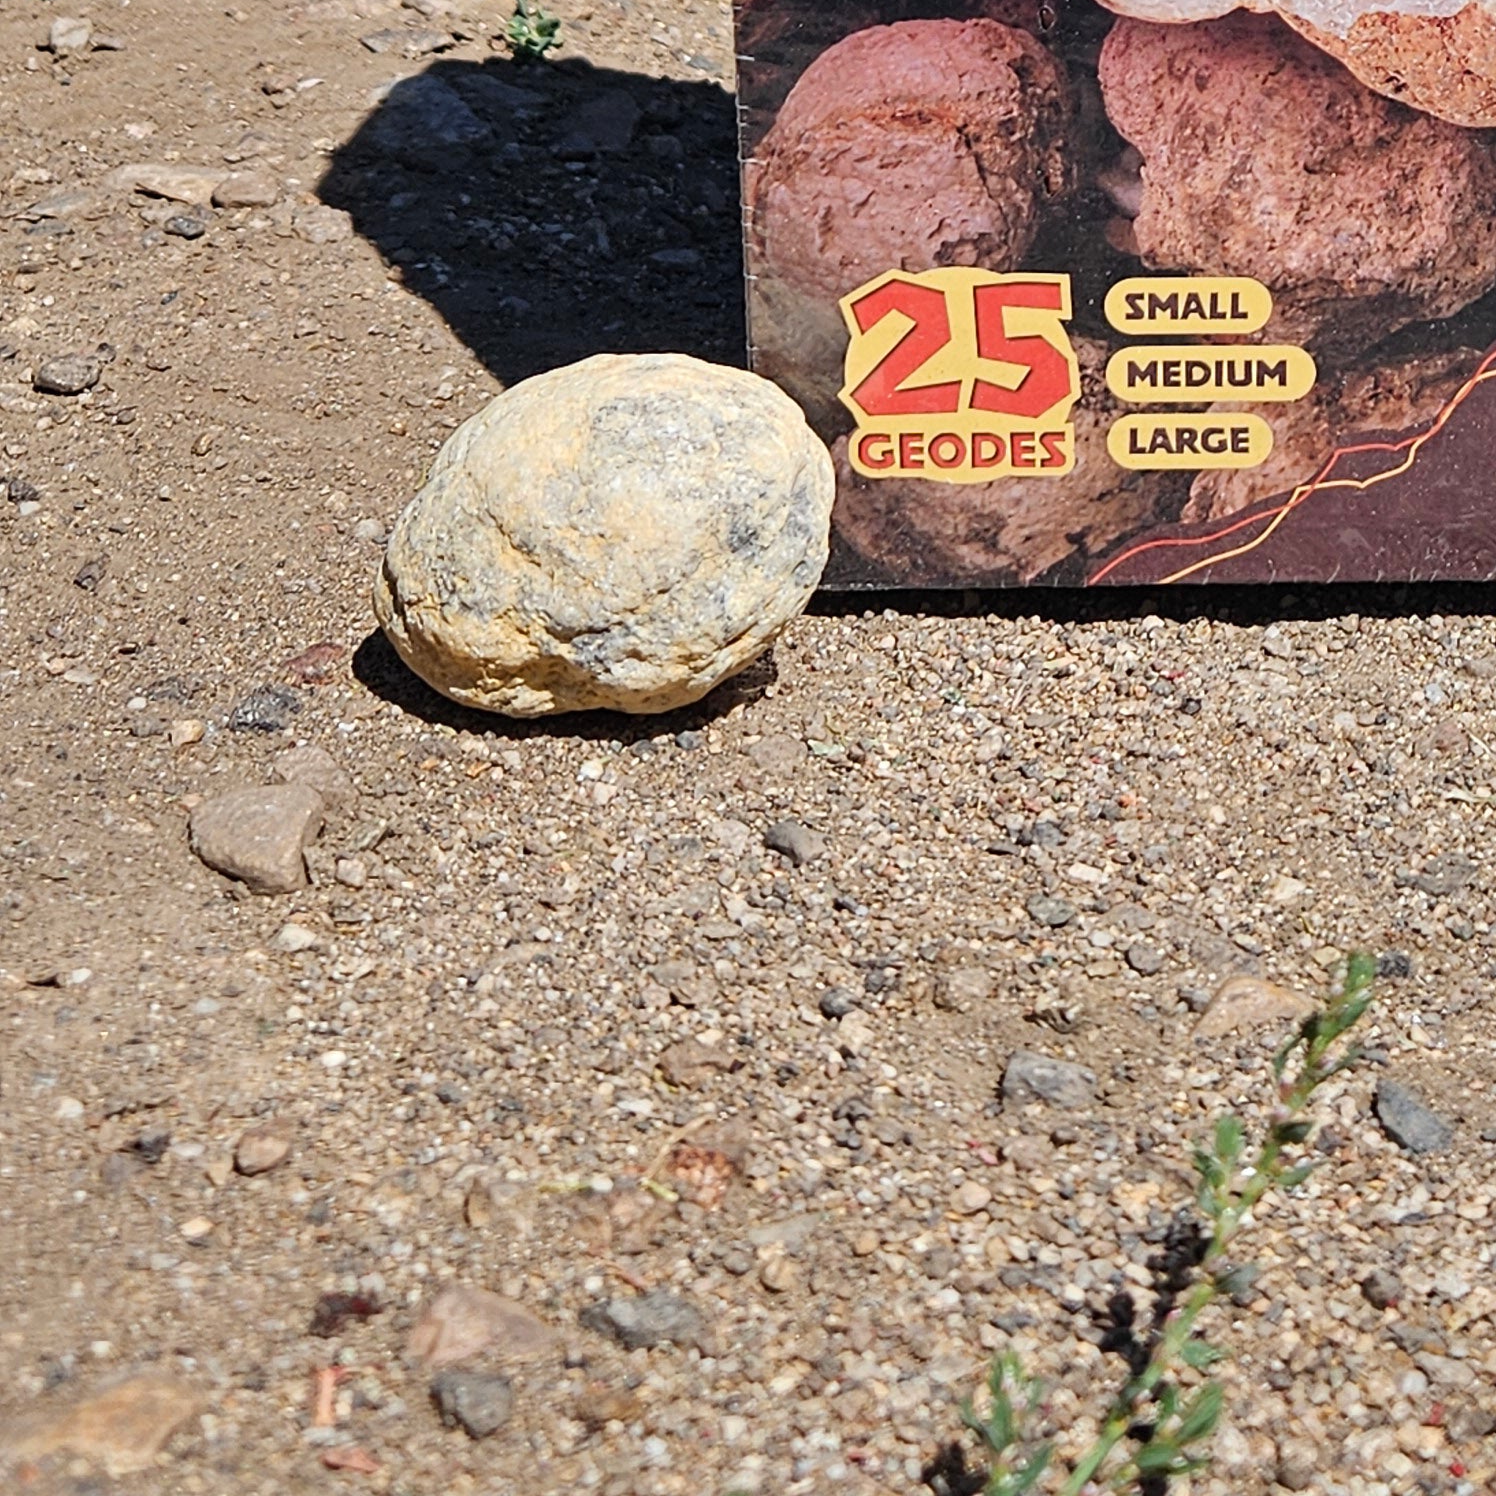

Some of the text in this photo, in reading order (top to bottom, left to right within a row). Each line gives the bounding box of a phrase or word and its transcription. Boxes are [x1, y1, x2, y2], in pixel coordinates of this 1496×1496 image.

[1124, 291, 1249, 321] SMALL
[850, 278, 1071, 418] 25
[1126, 359, 1288, 388] MEDIUM
[858, 431, 1067, 469] GEODES
[1129, 427, 1250, 455] LARGE
